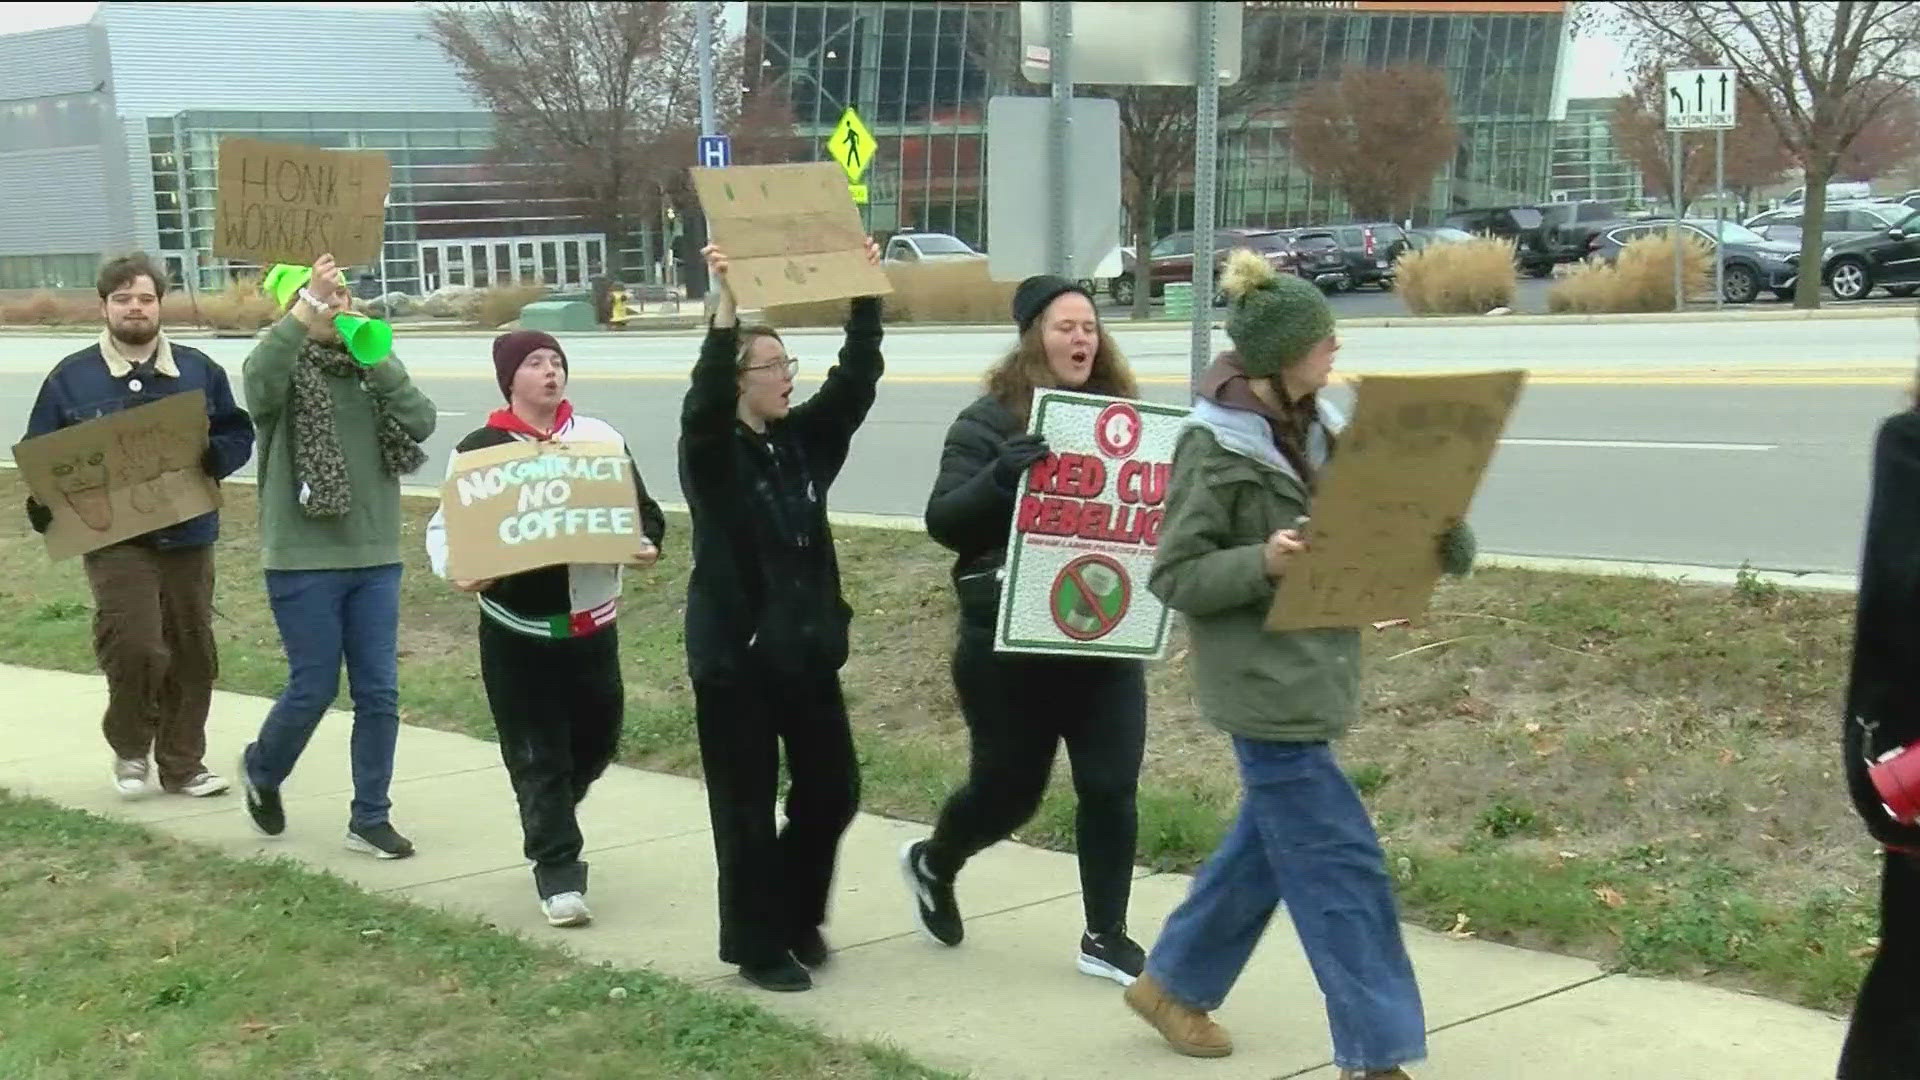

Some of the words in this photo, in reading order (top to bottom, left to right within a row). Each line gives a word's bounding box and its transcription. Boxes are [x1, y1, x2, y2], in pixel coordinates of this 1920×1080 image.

[705, 141, 724, 168] H
[241, 155, 339, 207] HONK
[518, 479, 572, 513] NO
[1029, 451, 1107, 499] RED
[498, 507, 634, 544] COFFEE
[1016, 494, 1166, 546] REBELLIO
